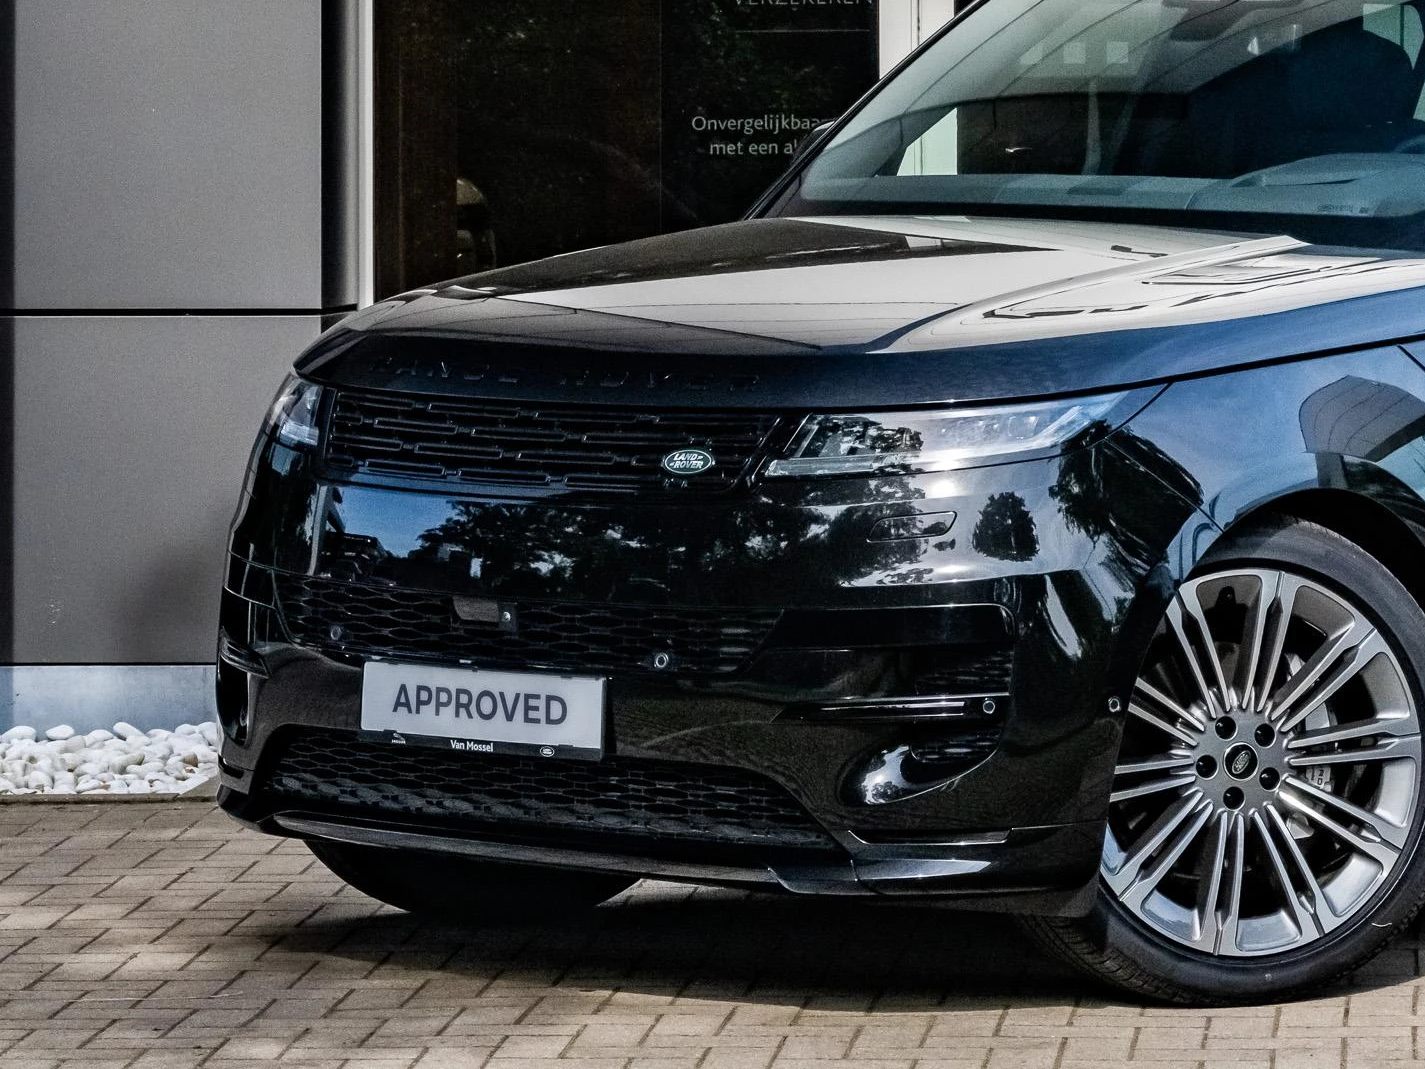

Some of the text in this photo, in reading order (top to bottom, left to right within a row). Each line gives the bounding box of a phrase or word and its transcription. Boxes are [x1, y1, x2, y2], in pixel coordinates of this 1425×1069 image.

[692, 114, 830, 136] Onvergelijkbaa
[709, 141, 744, 155] met
[748, 143, 778, 155] een
[673, 453, 699, 461] LAND
[673, 461, 704, 469] ROVER
[392, 684, 568, 726] APPROVED
[450, 739, 494, 753] Van Mossel
